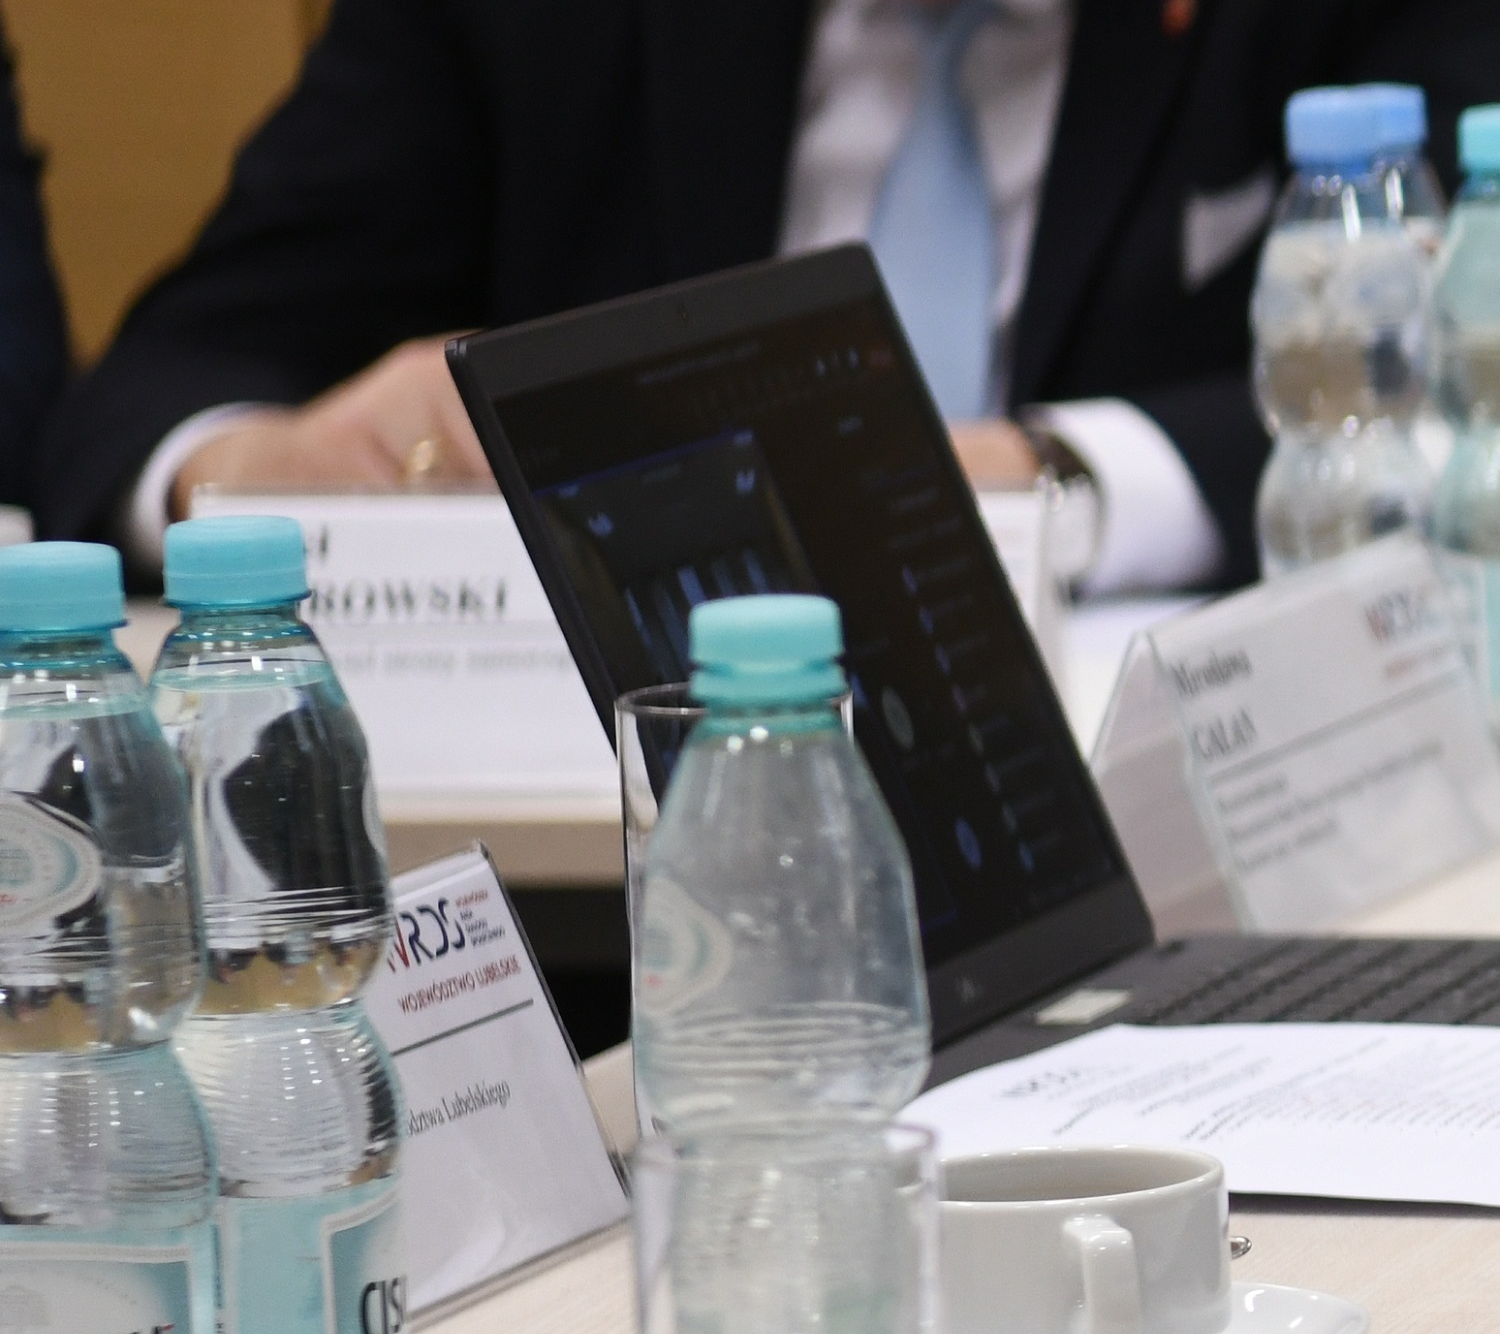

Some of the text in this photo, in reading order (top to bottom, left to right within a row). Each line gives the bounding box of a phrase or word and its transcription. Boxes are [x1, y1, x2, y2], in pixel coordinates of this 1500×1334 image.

[398, 954, 522, 1014] WOJEWÓDZTWO LUBELSKIE
[441, 1079, 511, 1122] Lubelskiego
